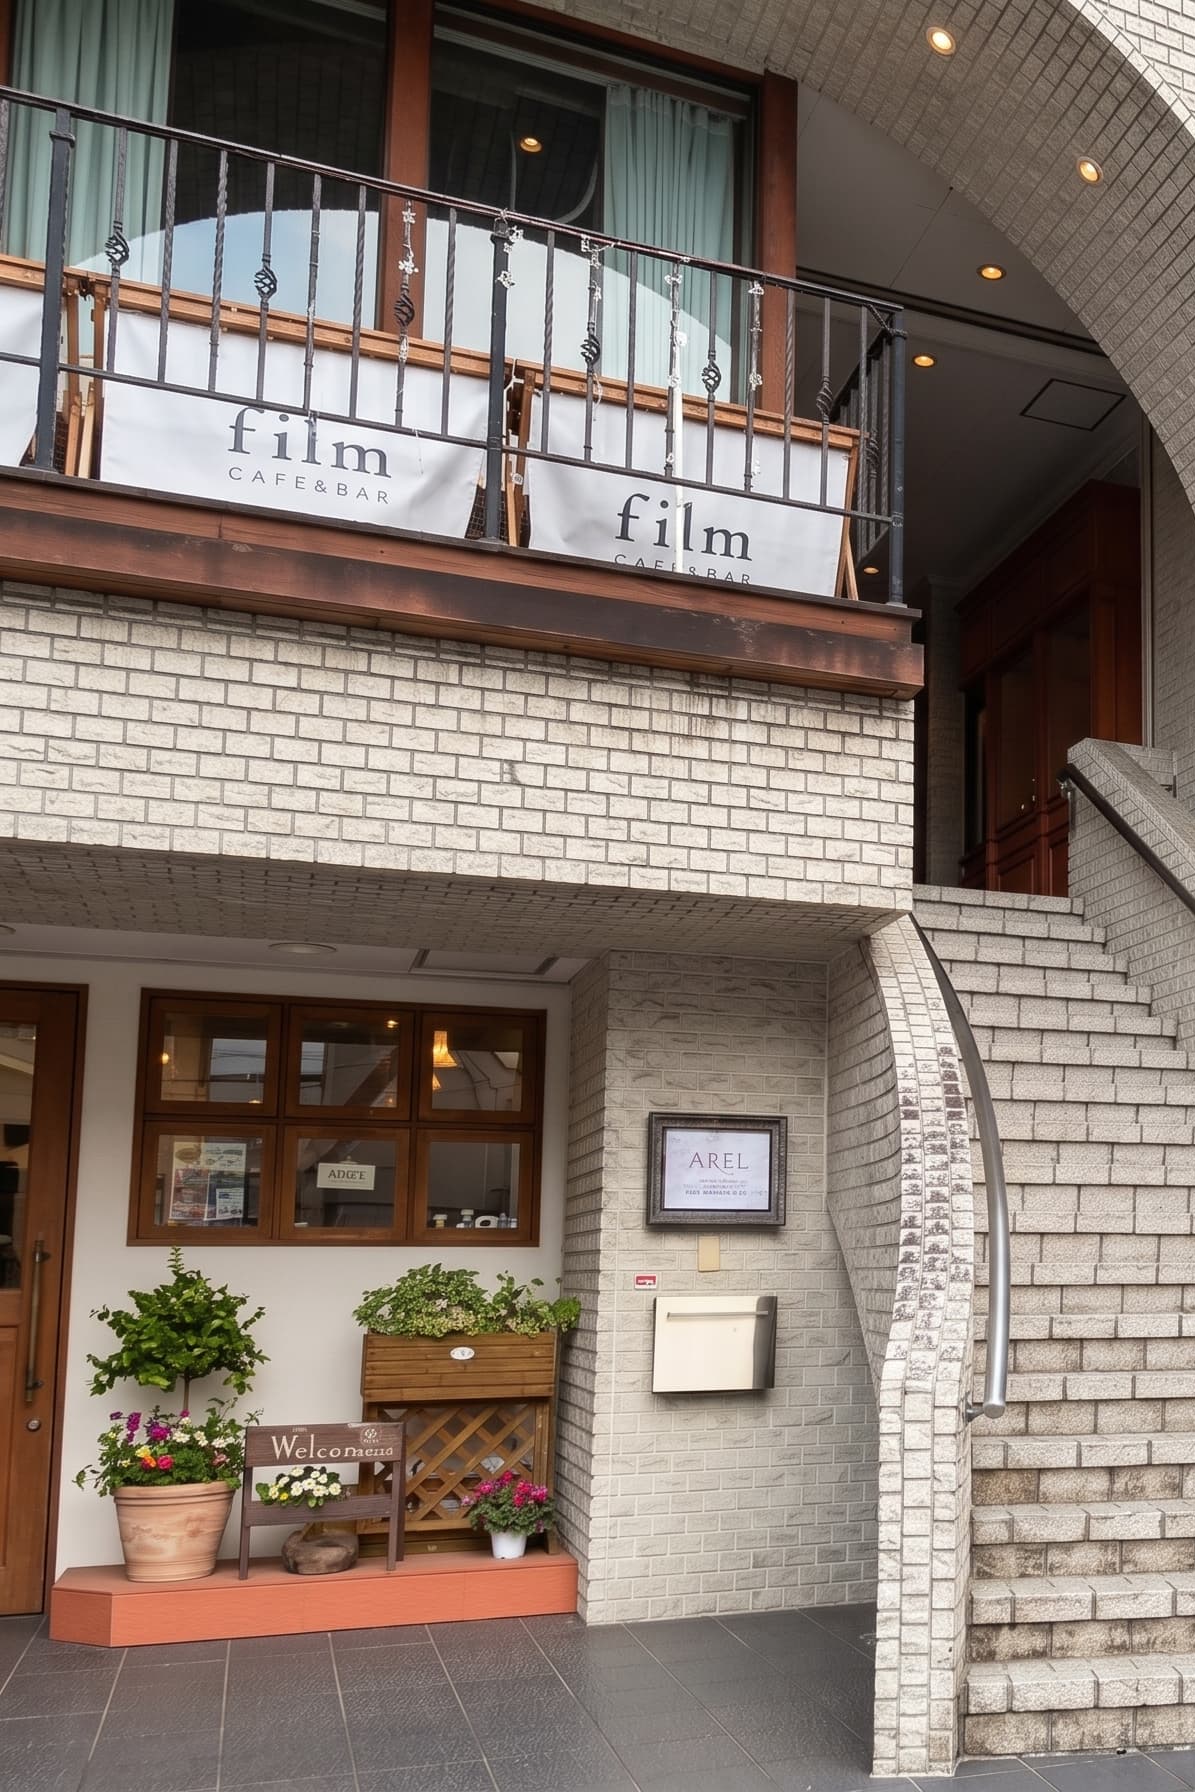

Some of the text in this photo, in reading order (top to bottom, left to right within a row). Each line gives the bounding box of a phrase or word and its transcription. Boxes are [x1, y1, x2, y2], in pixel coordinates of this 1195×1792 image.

[228, 405, 392, 479] film
[228, 466, 389, 505] CAFE&BAR
[615, 492, 753, 562] film
[689, 1151, 749, 1176] AREL
